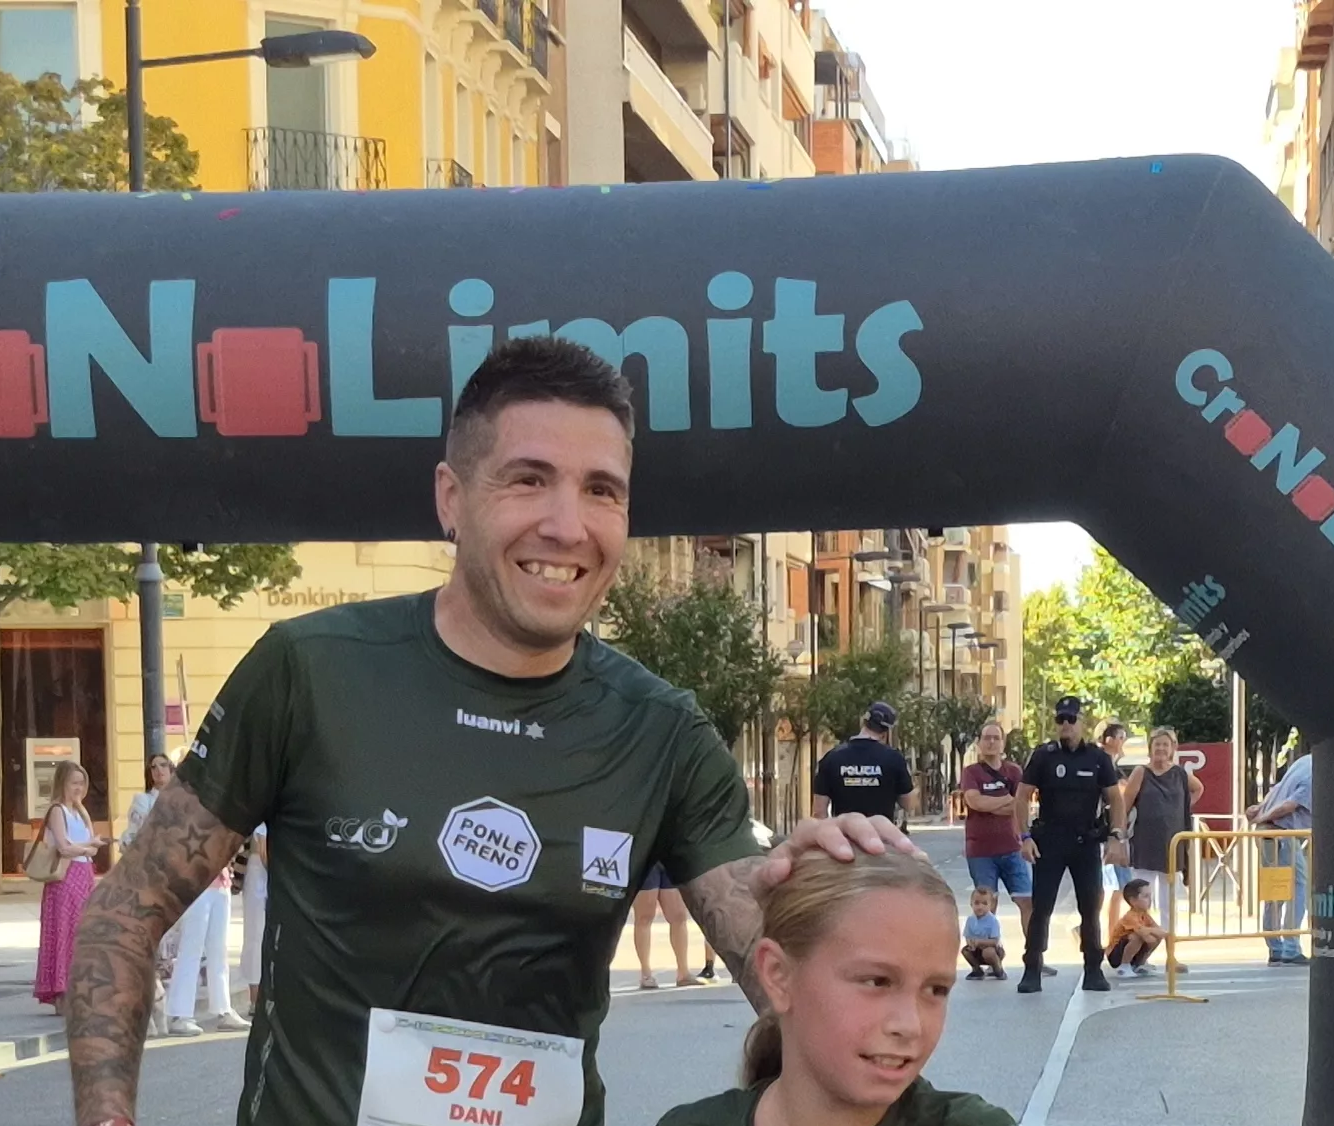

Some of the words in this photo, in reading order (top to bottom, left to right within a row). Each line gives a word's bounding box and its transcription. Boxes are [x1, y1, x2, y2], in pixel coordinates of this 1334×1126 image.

[456, 708, 521, 735] luanvi
[452, 834, 520, 872] FRENO
[460, 818, 528, 857] PONLE
[584, 856, 621, 881] AXA
[424, 1046, 536, 1107] 574
